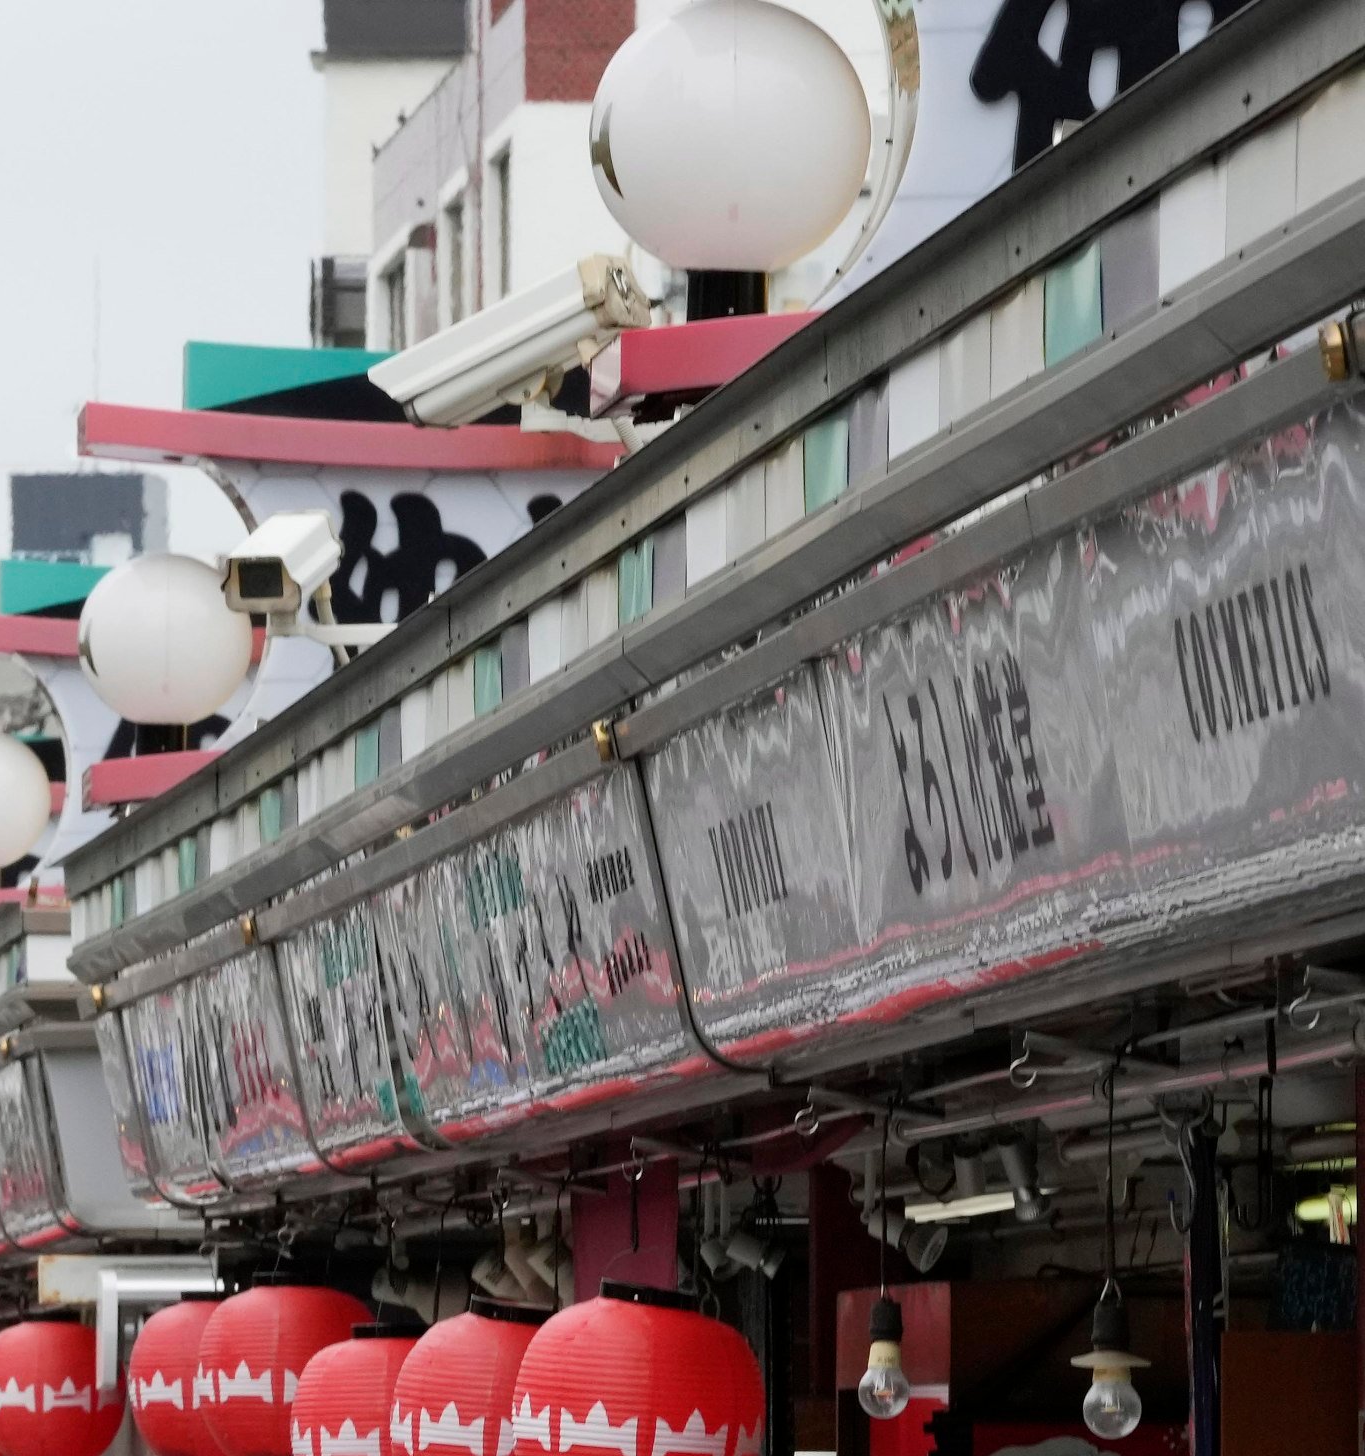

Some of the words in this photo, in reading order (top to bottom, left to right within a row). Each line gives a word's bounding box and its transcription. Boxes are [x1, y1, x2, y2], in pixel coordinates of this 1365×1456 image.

[1175, 562, 1331, 743] COSMETICS
[708, 801, 789, 920] YOROSHI
[882, 649, 1055, 895] よろし化粧堂
